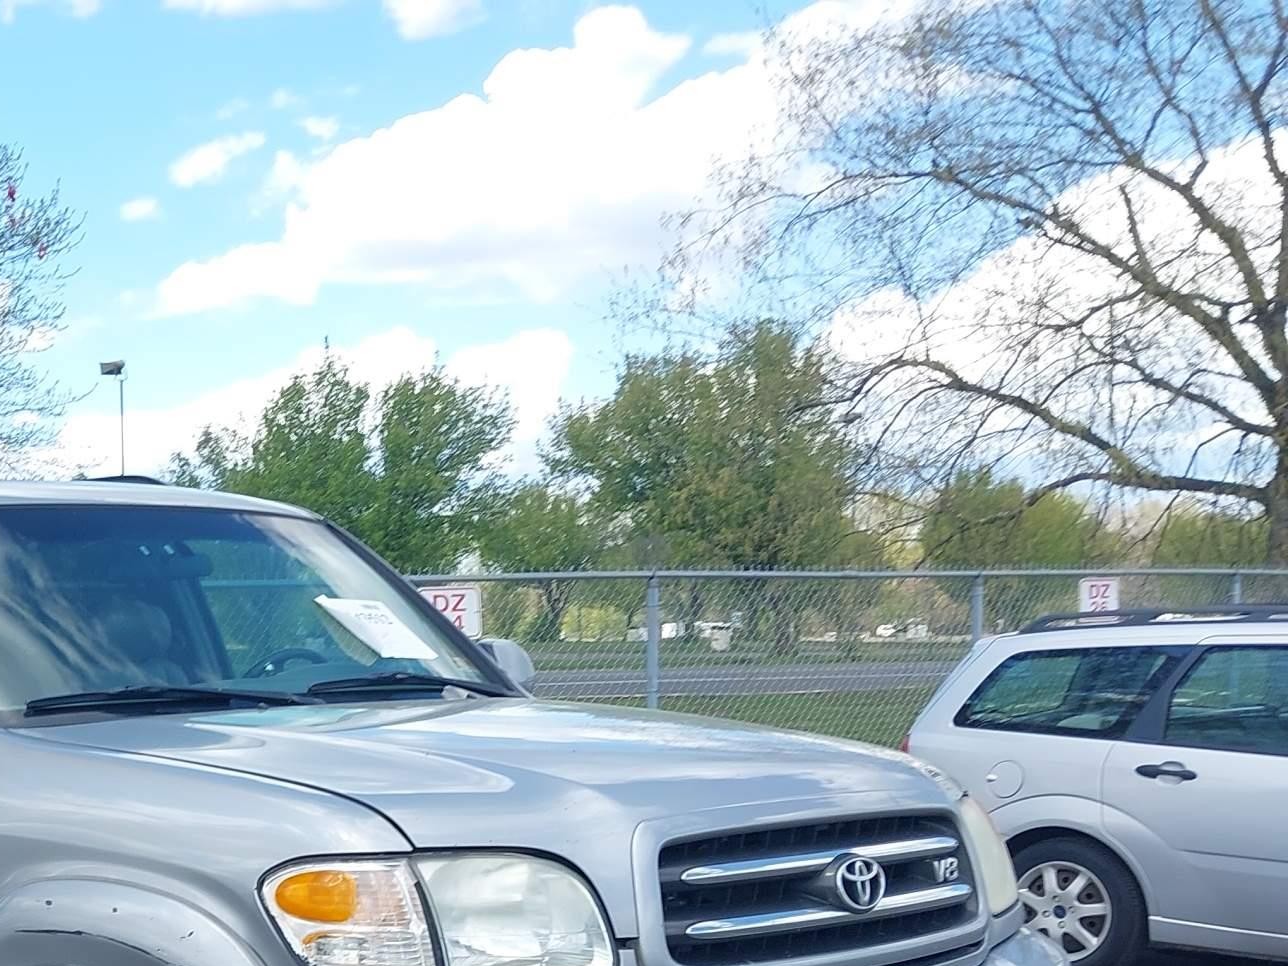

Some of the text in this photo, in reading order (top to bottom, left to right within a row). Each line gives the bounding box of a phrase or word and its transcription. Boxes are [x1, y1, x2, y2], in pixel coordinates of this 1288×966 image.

[1089, 584, 1111, 600] DZ
[433, 594, 467, 612] DZ
[452, 615, 465, 630] 4
[932, 857, 960, 883] V8
